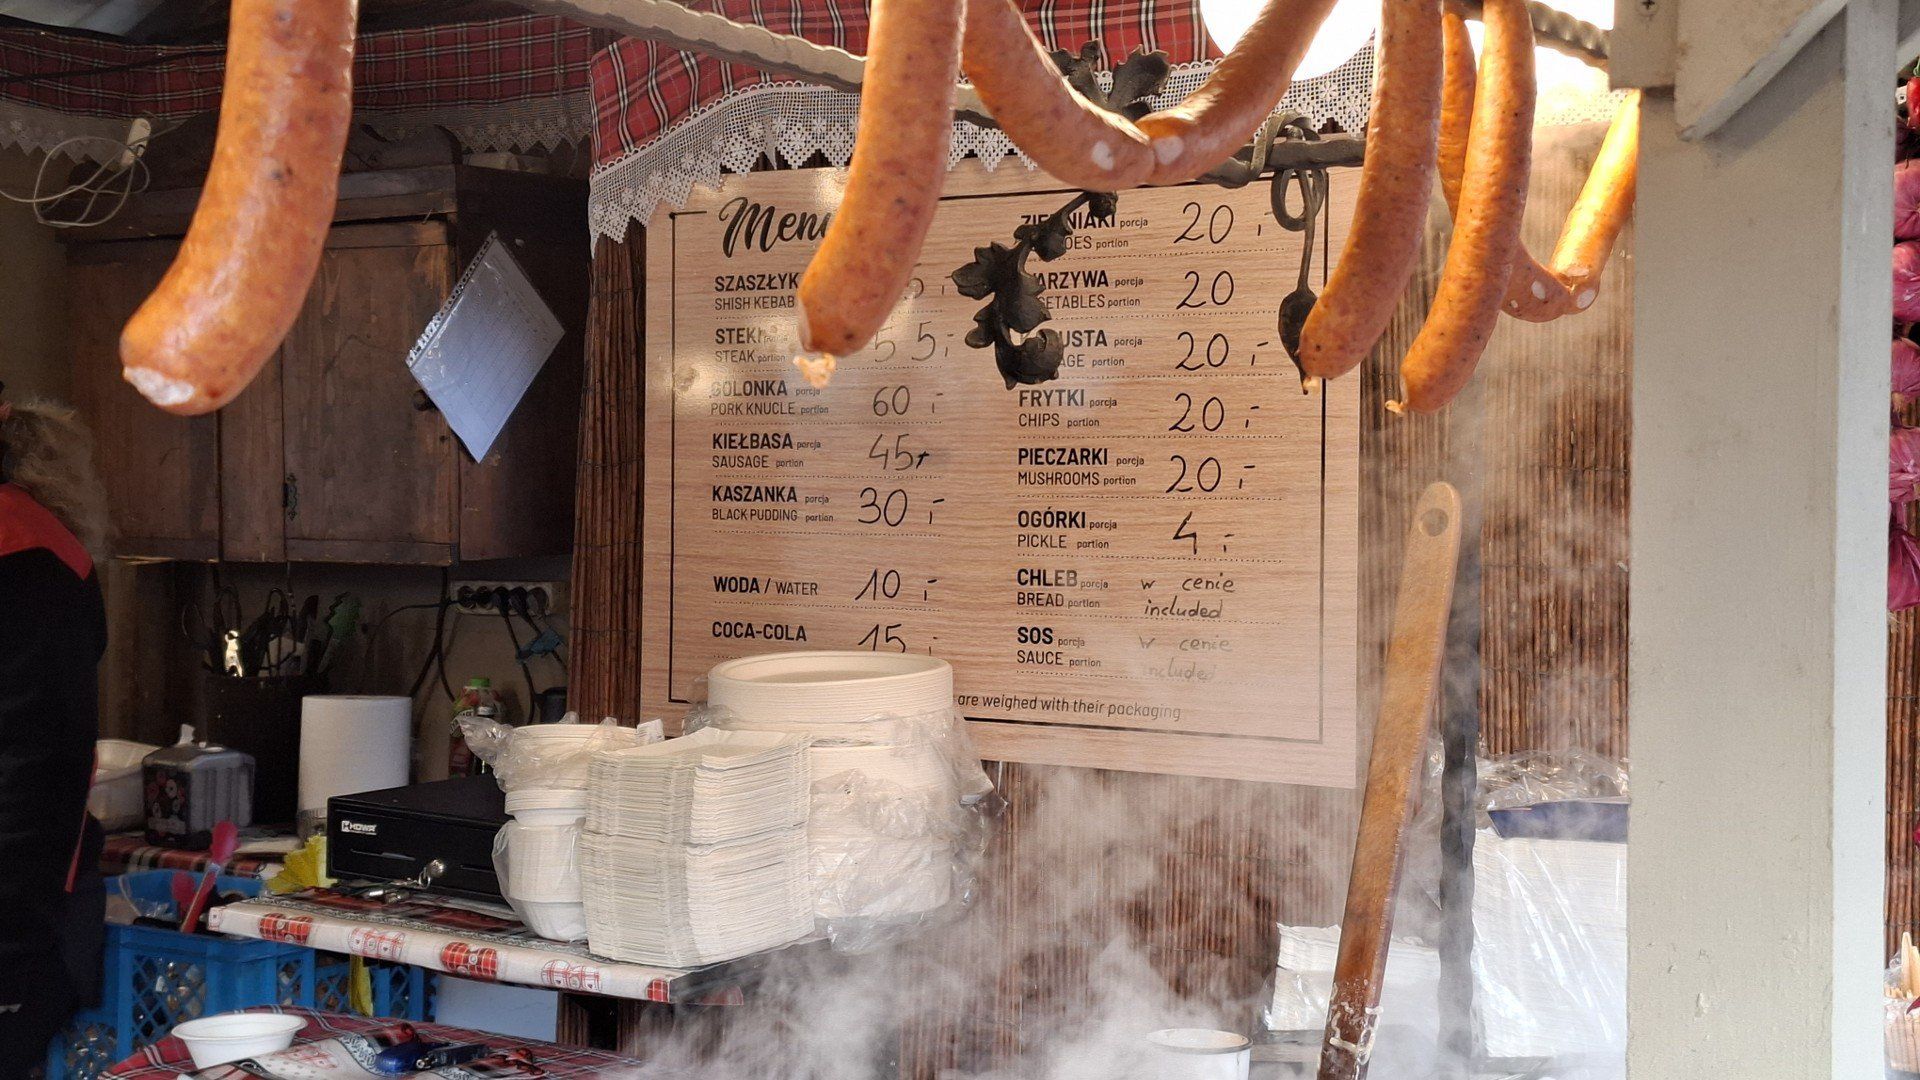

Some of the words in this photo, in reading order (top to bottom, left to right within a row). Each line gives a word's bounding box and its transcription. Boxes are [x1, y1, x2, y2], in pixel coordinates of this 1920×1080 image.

[1120, 219, 1148, 229] porcja
[1096, 239, 1129, 250] portion
[714, 272, 800, 292] SZASZŁYK
[1033, 270, 1109, 289] ARZYWA
[1114, 276, 1144, 288] porcja
[1176, 270, 1235, 310] 20
[714, 298, 751, 311] SHISH
[753, 295, 795, 309] KEBAB
[1107, 296, 1140, 308] portion
[1059, 329, 1108, 347] USTA
[1113, 337, 1143, 348] porcja
[715, 349, 755, 362] STEAK
[757, 353, 786, 364] portion
[1092, 356, 1125, 367] portion
[711, 380, 787, 396] GOLONKA
[795, 387, 820, 396] porcja
[1018, 389, 1085, 408] FRYTKI
[1089, 397, 1118, 408] porcja
[710, 402, 743, 416] PORK
[746, 402, 795, 415] KNUCLE
[800, 405, 829, 416] portion
[1018, 413, 1060, 427] CHIPS
[1066, 417, 1100, 428] portion
[712, 432, 793, 450] KIEŁBASA
[796, 439, 821, 450] porcja
[711, 455, 769, 468] SAUSAGE
[775, 458, 804, 469] portion
[1018, 448, 1108, 466] PIECZARKI
[1116, 456, 1145, 467] porcja
[1017, 472, 1100, 486] MUSHROOMS
[1103, 475, 1136, 487] portion
[712, 485, 798, 503] KASZANKA
[804, 494, 830, 505] porcja
[712, 508, 748, 521] BLACK
[750, 509, 798, 522] PUDDING
[805, 513, 834, 523] portion
[1017, 507, 1086, 529] OGÓRKI
[1089, 520, 1118, 531] porcja
[1017, 534, 1067, 548] PICKLE
[1076, 539, 1109, 550] portion
[713, 575, 760, 594] WODA
[774, 581, 819, 596] WATER
[1017, 569, 1078, 587] CHLEB
[1080, 580, 1109, 590] porcja
[1181, 572, 1236, 593] cenie
[1017, 592, 1064, 608] BREAD
[1067, 598, 1100, 609] portion
[1144, 595, 1223, 619] included
[712, 621, 807, 642] COCA-COLA
[1017, 627, 1054, 645] SOS
[1058, 637, 1085, 648] porcja
[1017, 650, 1064, 666] SAUCE
[1069, 657, 1101, 668] portion
[958, 694, 979, 706] are
[982, 694, 1037, 712] weighed
[1040, 697, 1069, 712] with
[1073, 698, 1104, 714] their
[1108, 701, 1181, 722] packaging
